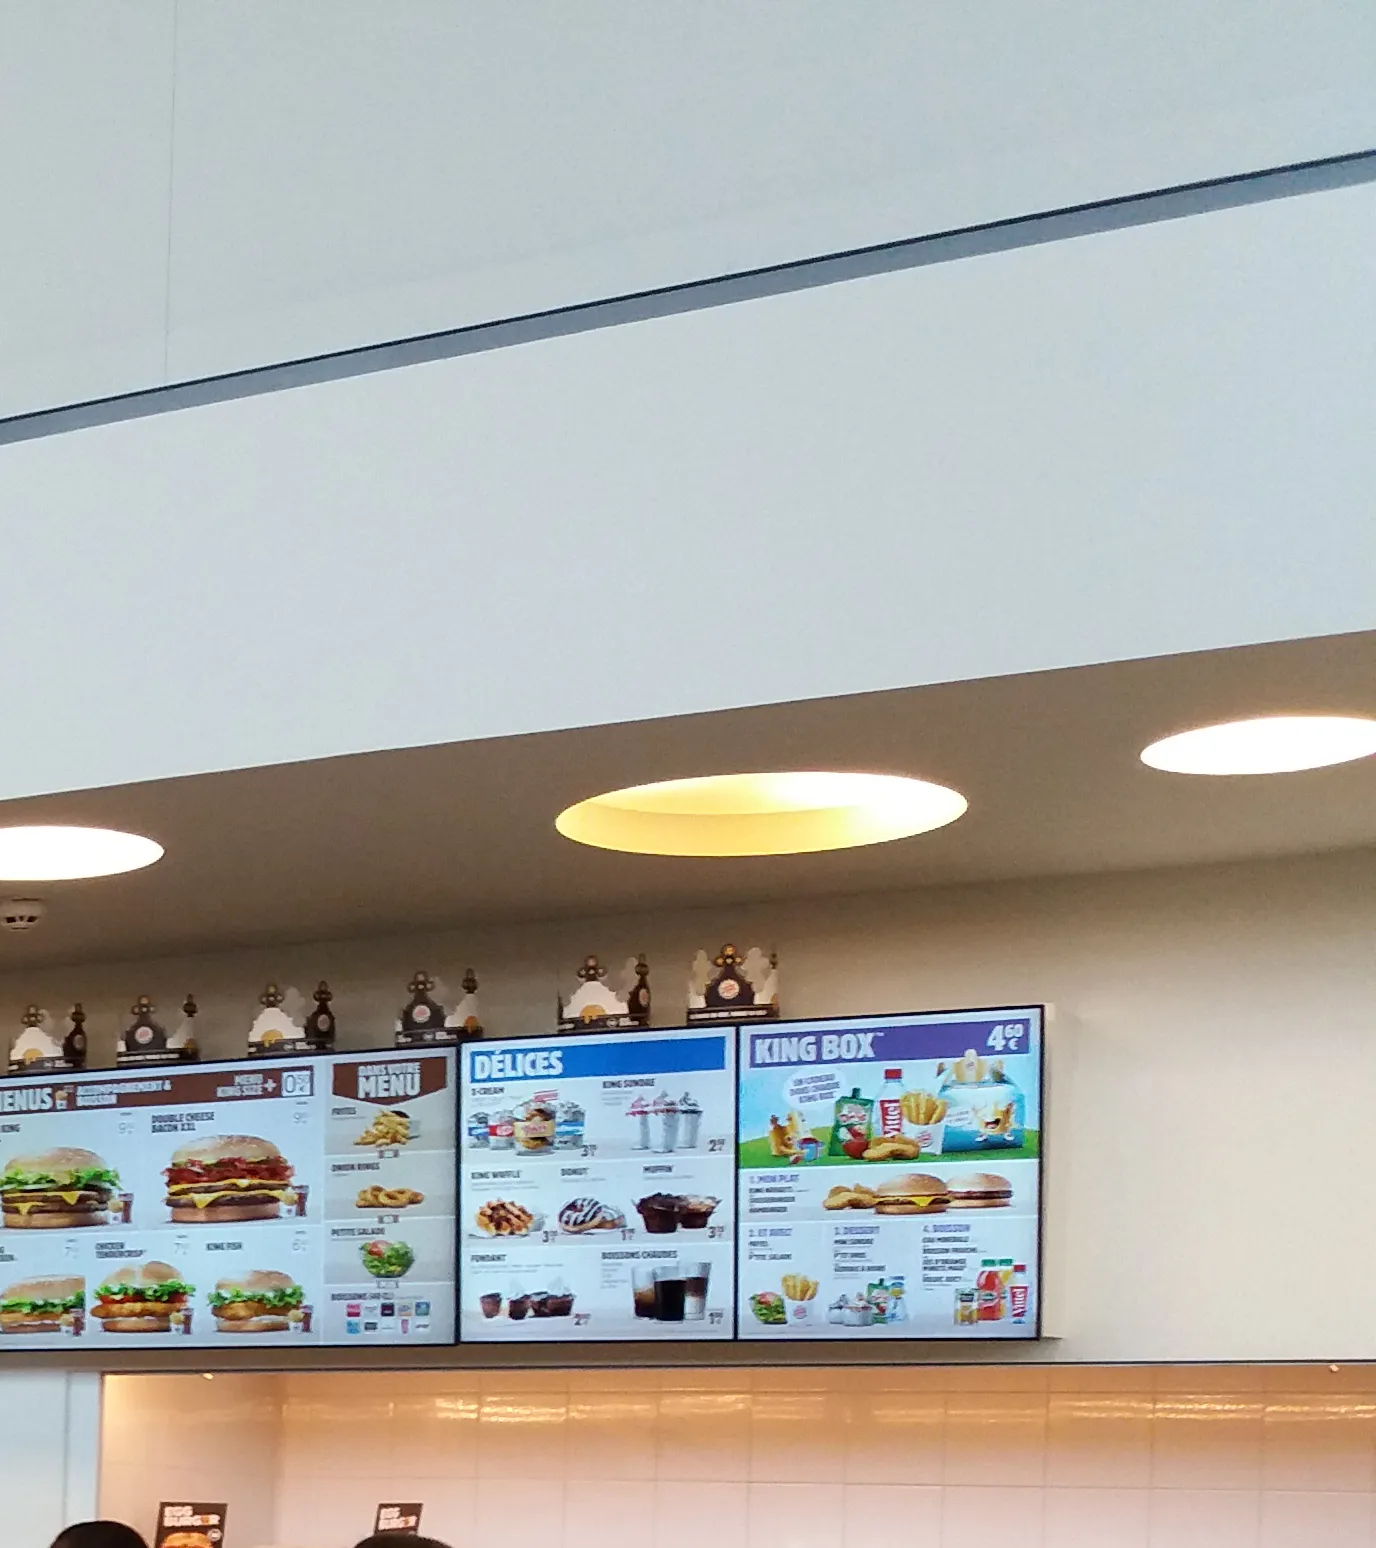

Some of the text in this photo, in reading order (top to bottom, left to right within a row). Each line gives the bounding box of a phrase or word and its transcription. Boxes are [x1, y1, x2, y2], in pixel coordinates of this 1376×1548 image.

[755, 1032, 876, 1064] KING BOX
[474, 1049, 564, 1080] DÉLICES
[357, 1073, 421, 1099] MENU
[151, 1111, 215, 1124] DOUBLE CHEESE
[151, 1123, 179, 1134] BACON
[164, 1505, 194, 1517] EGG
